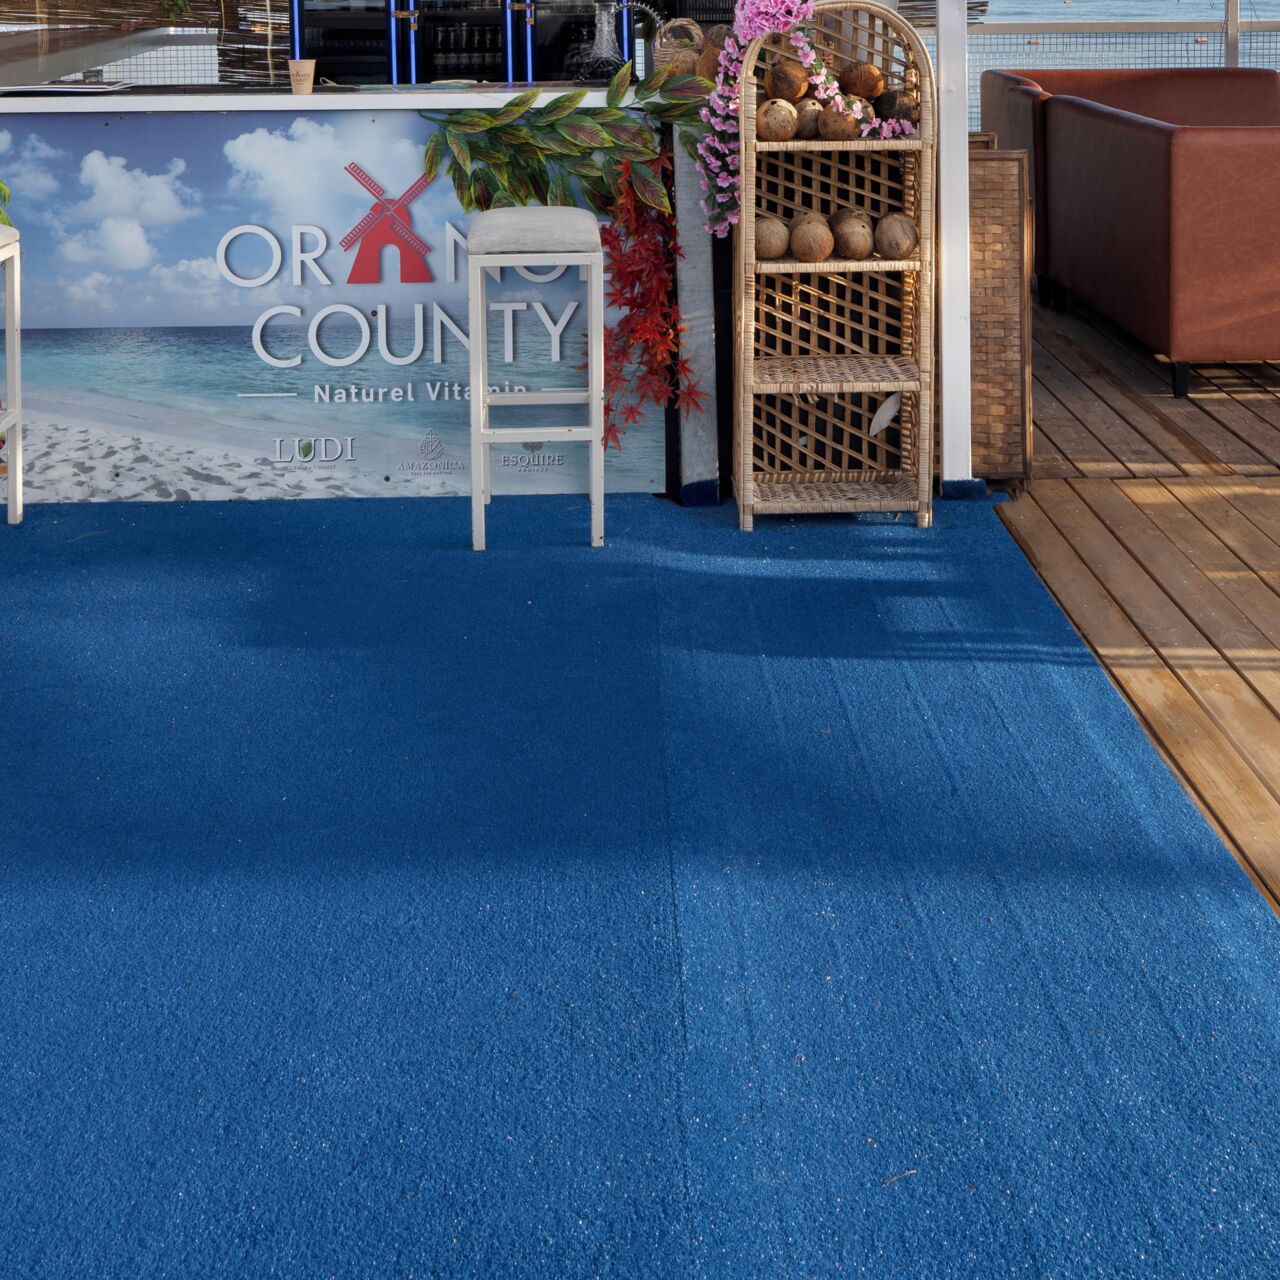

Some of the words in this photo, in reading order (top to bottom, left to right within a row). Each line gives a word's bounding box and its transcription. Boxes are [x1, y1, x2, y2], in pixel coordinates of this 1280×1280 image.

[251, 300, 580, 368] COUNTY
[314, 382, 415, 404] Naturel
[273, 436, 357, 463] LUDI
[398, 460, 466, 472] AMAZONICA
[500, 454, 565, 468] ESQUIRE
